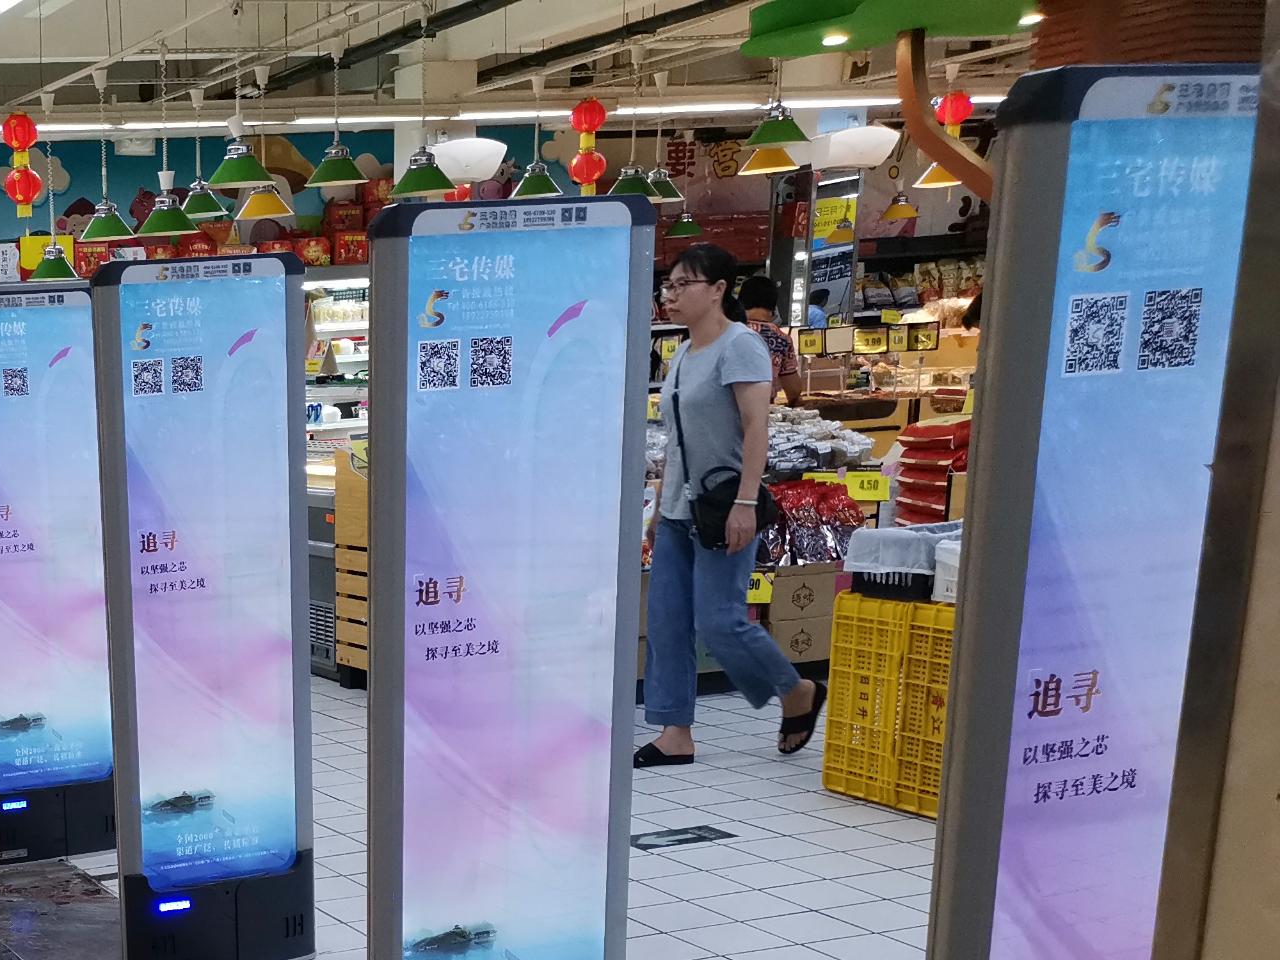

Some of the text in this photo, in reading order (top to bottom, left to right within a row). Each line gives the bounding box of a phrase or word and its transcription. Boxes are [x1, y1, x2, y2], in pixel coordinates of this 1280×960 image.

[427, 254, 516, 281] 三宅传媒
[859, 479, 879, 491] 4.50
[140, 530, 179, 553] 追寻
[140, 561, 187, 575] 以坚强之芯
[149, 577, 206, 594] 探寻至美之境
[415, 575, 469, 607] 追寻
[414, 617, 477, 636] 以坚强之芯
[425, 639, 500, 661] 探寻至美之境
[1027, 669, 1103, 719] 追寻
[1022, 734, 1110, 766] 以坚强之芯
[1034, 768, 1137, 804] 探寻至美之境
